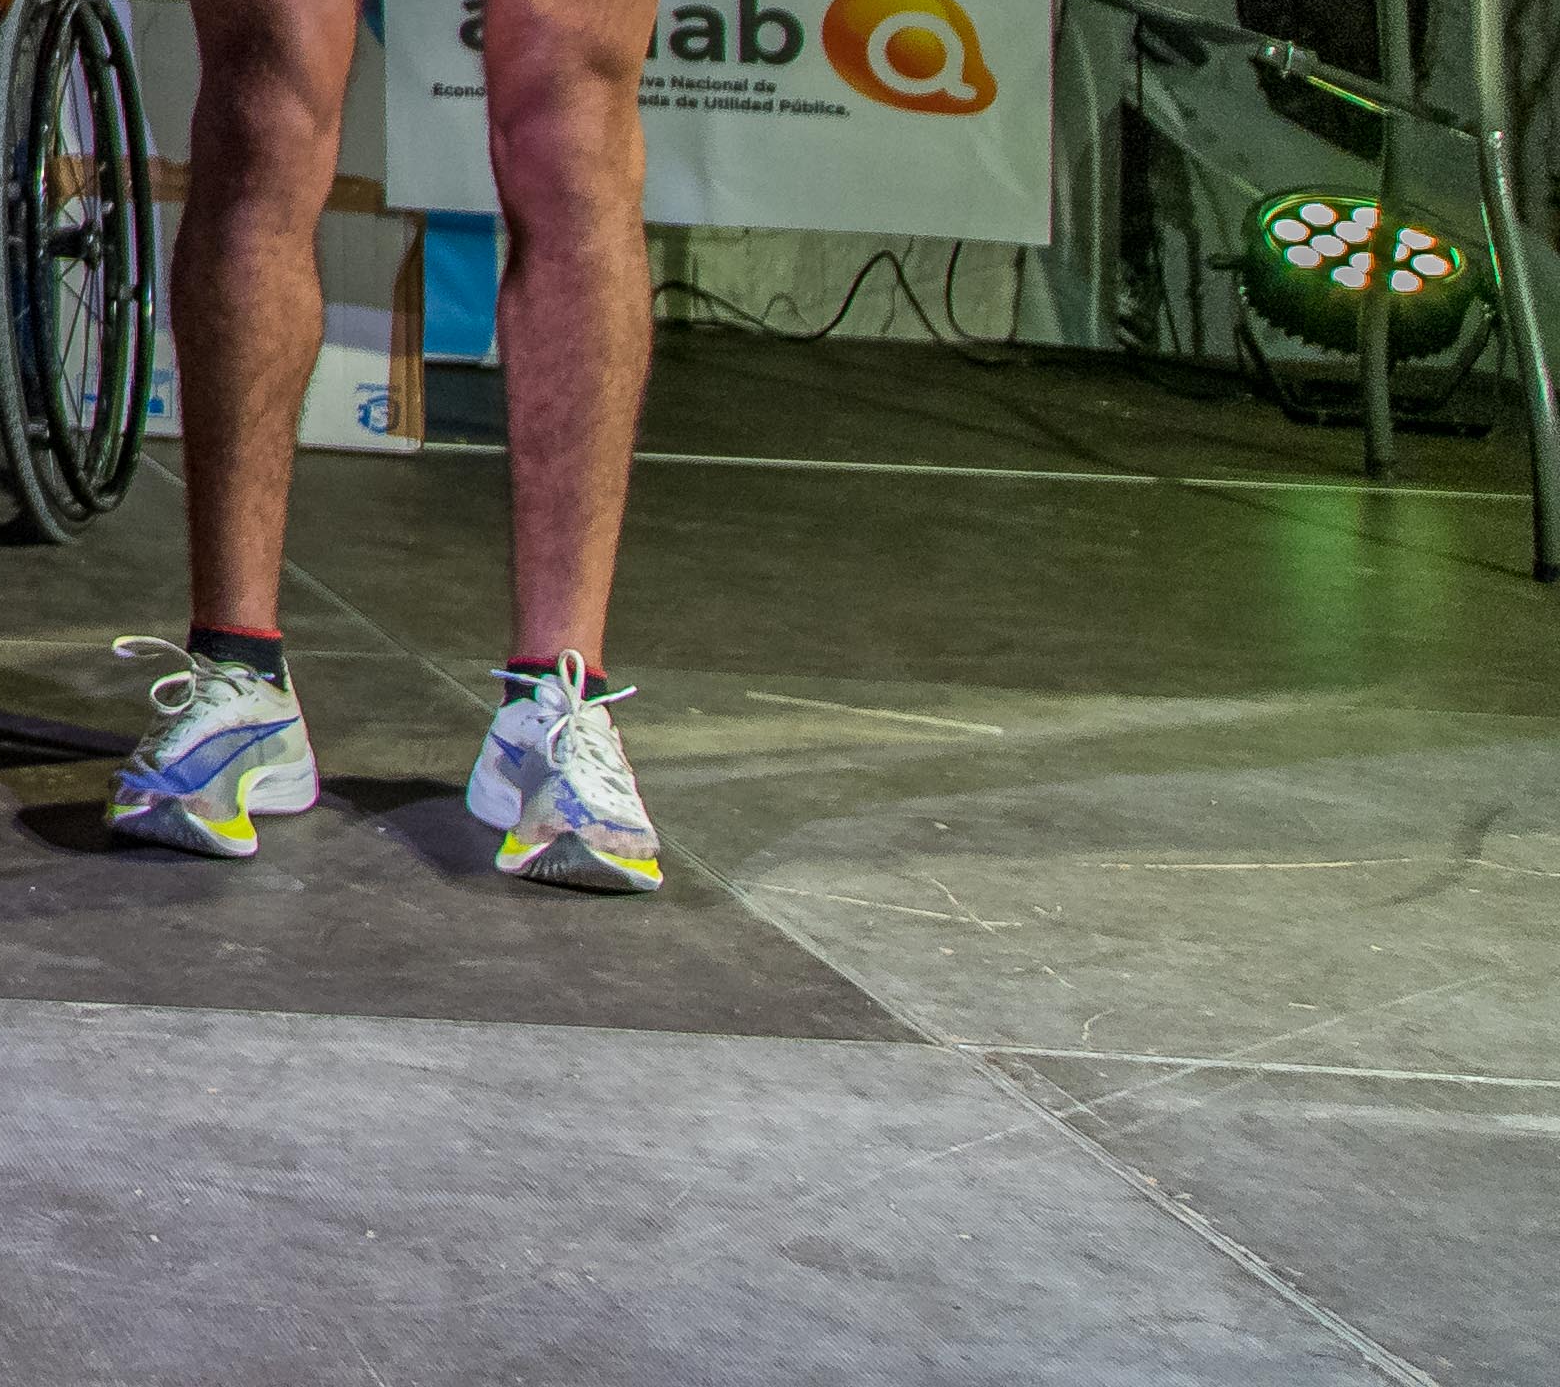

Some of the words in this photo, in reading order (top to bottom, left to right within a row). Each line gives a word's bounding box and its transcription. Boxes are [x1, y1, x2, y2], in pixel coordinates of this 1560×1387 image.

[671, 75, 748, 92] Nacional
[753, 78, 776, 93] de
[432, 83, 488, 97] Econo
[638, 95, 669, 109] ada
[675, 95, 698, 109] de
[703, 95, 773, 112] Utilidad
[779, 96, 851, 118] Pública.
